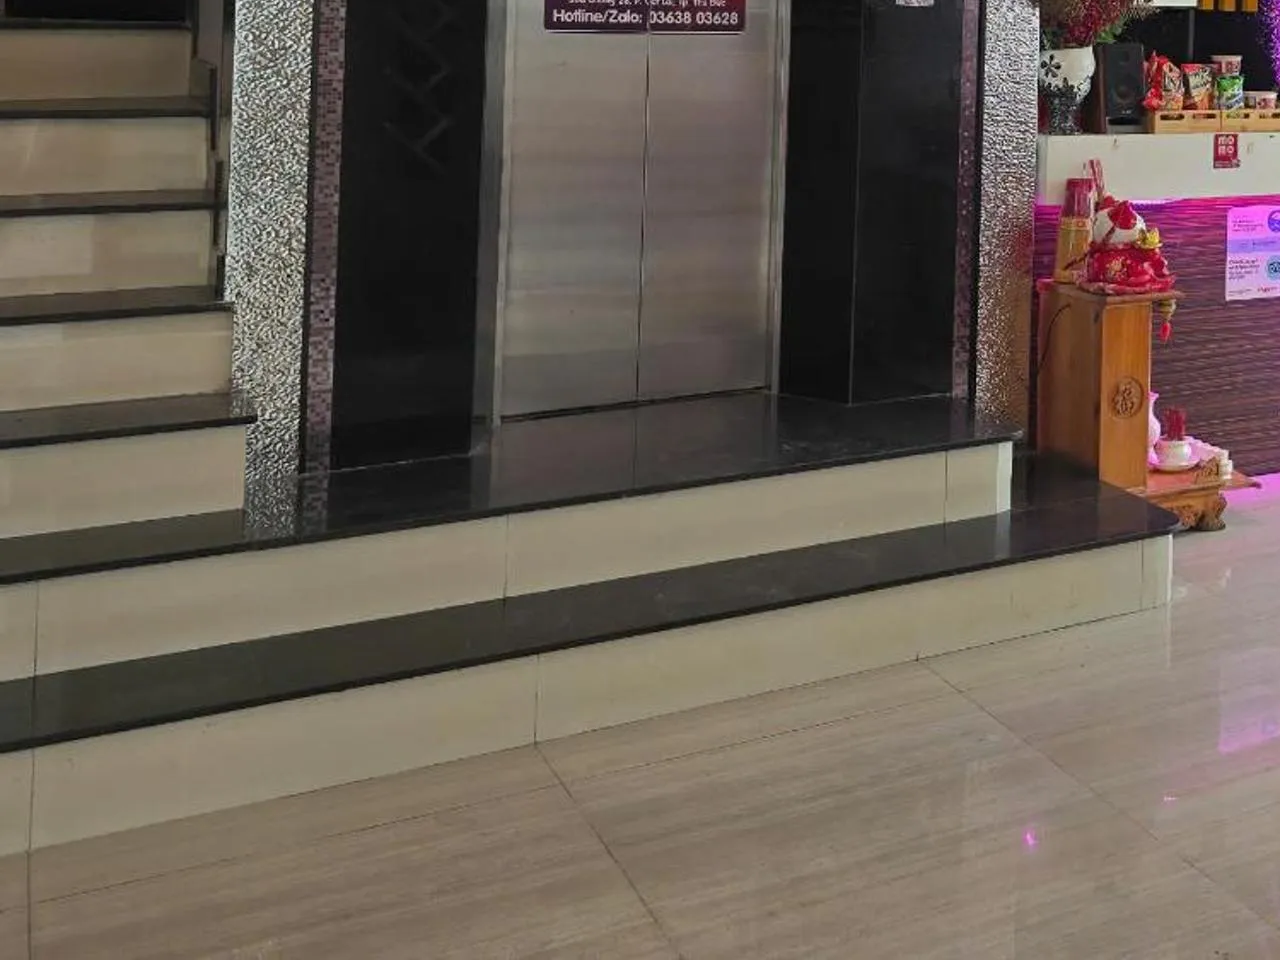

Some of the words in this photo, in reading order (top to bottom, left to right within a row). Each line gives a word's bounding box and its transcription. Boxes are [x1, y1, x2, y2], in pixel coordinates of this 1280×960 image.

[553, 9, 642, 24] Hotline/Zalo:
[649, 11, 691, 24] 03638
[696, 12, 738, 25] 03628
